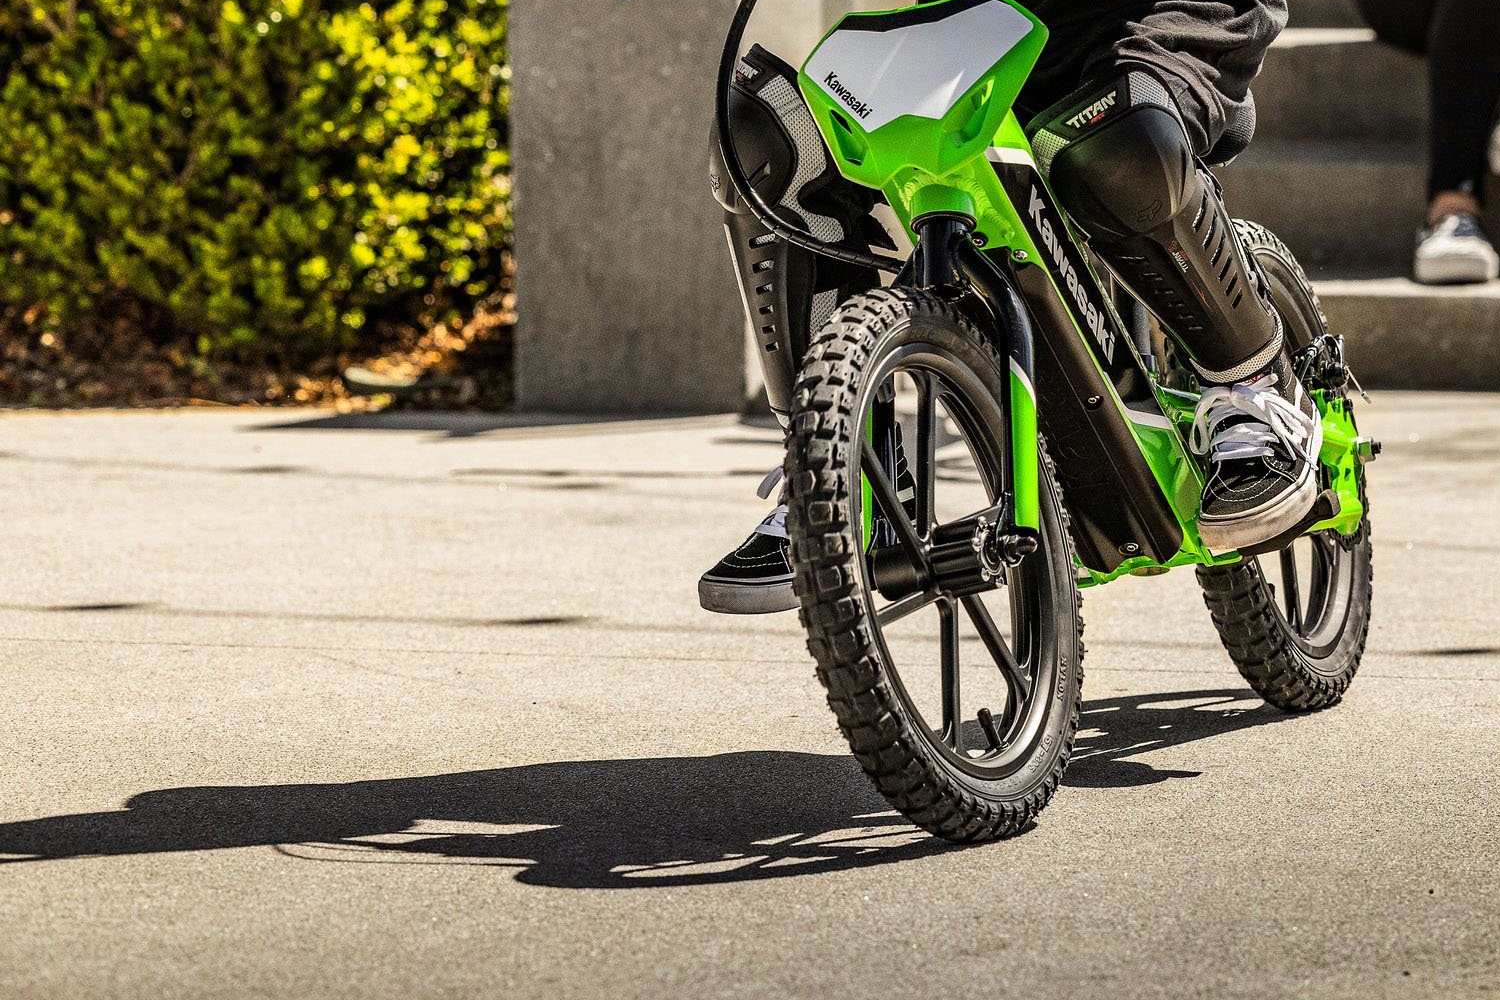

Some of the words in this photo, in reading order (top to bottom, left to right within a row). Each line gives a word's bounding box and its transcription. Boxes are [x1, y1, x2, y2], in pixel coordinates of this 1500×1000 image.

[823, 71, 873, 120] Kawasaki
[1065, 90, 1117, 129] TITAN
[1028, 184, 1116, 366] Kawasaki
[1172, 251, 1190, 273] TITAN
